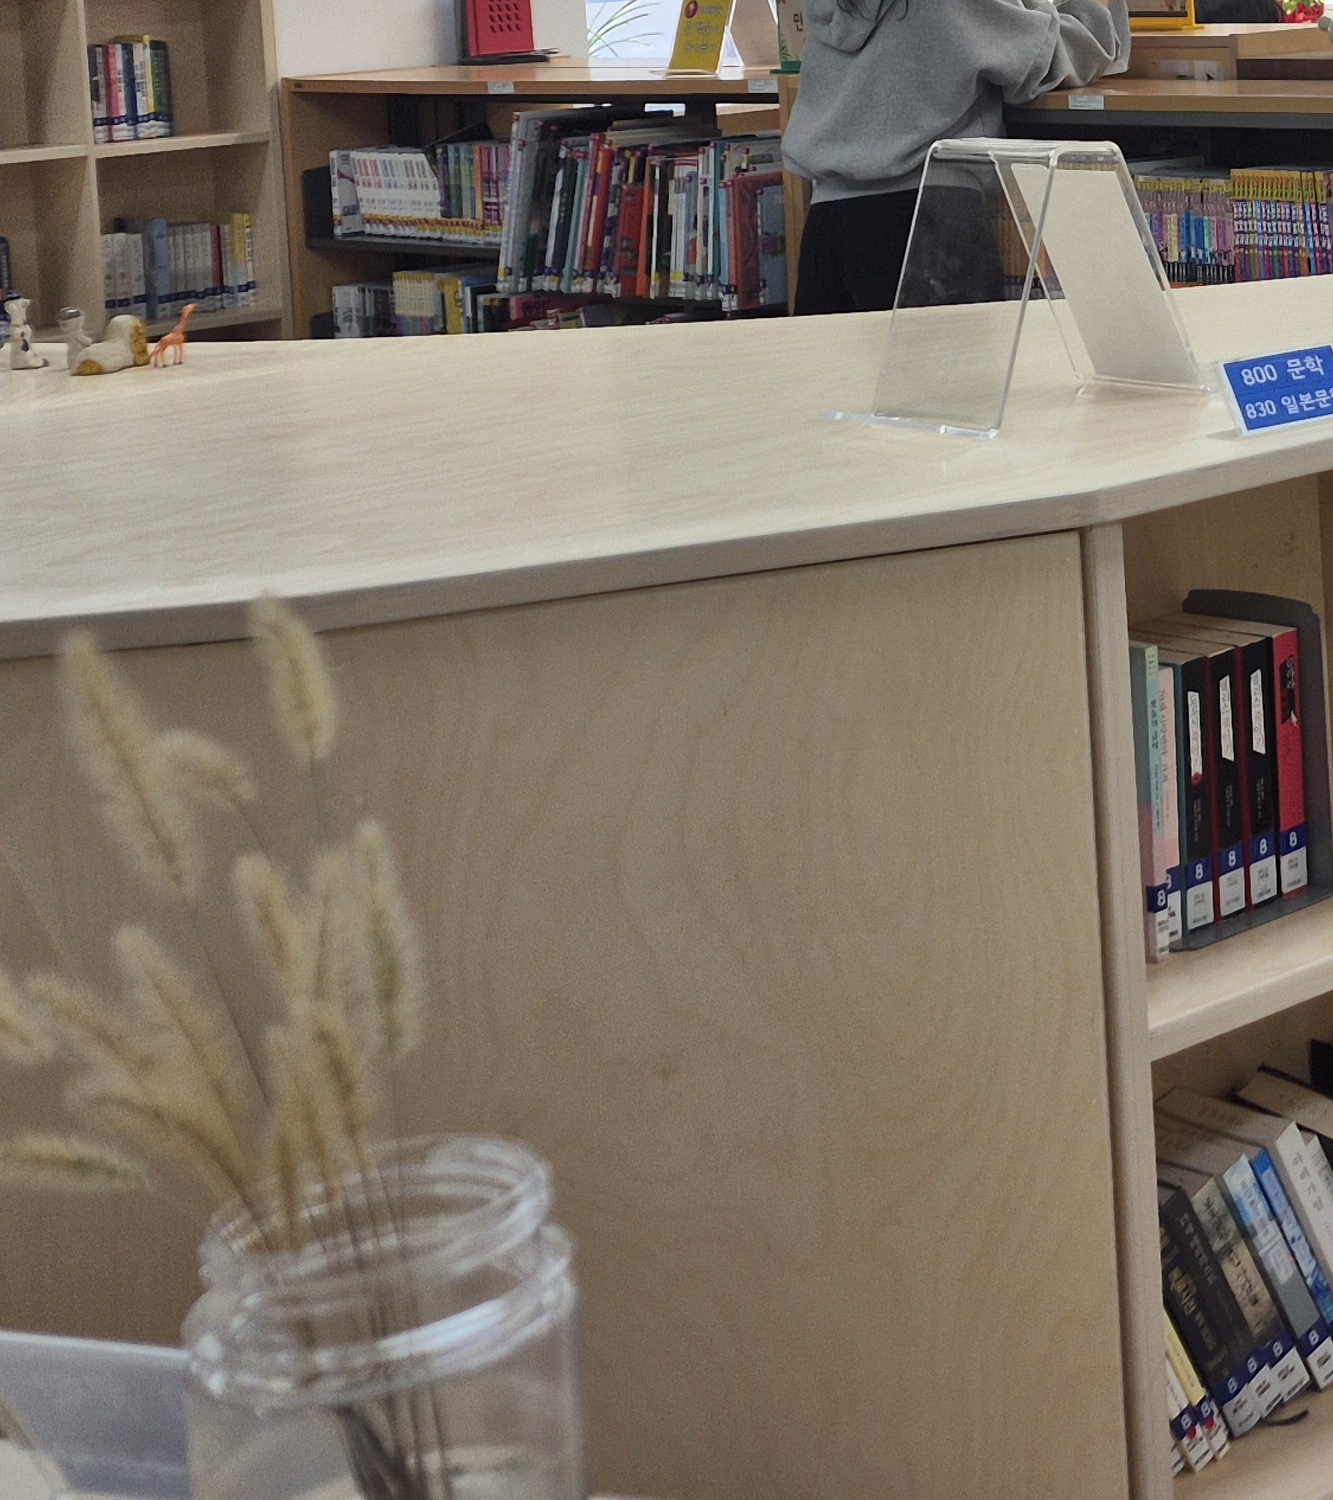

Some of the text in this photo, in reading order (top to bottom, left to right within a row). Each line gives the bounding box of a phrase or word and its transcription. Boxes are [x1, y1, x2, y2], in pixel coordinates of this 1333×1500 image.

[1241, 354, 1325, 386] 800 문학
[1245, 399, 1277, 419] 830
[1259, 838, 1268, 855] 8
[1289, 831, 1298, 847] 8
[1228, 850, 1237, 867] 8
[1195, 863, 1204, 880] 8
[1157, 889, 1166, 906] 8
[1308, 1329, 1319, 1346] 8
[1273, 1341, 1284, 1357] 8
[1247, 1357, 1258, 1374] 8
[1227, 1376, 1238, 1394] 8
[1201, 1401, 1211, 1418] 8
[1180, 1413, 1192, 1430] 8
